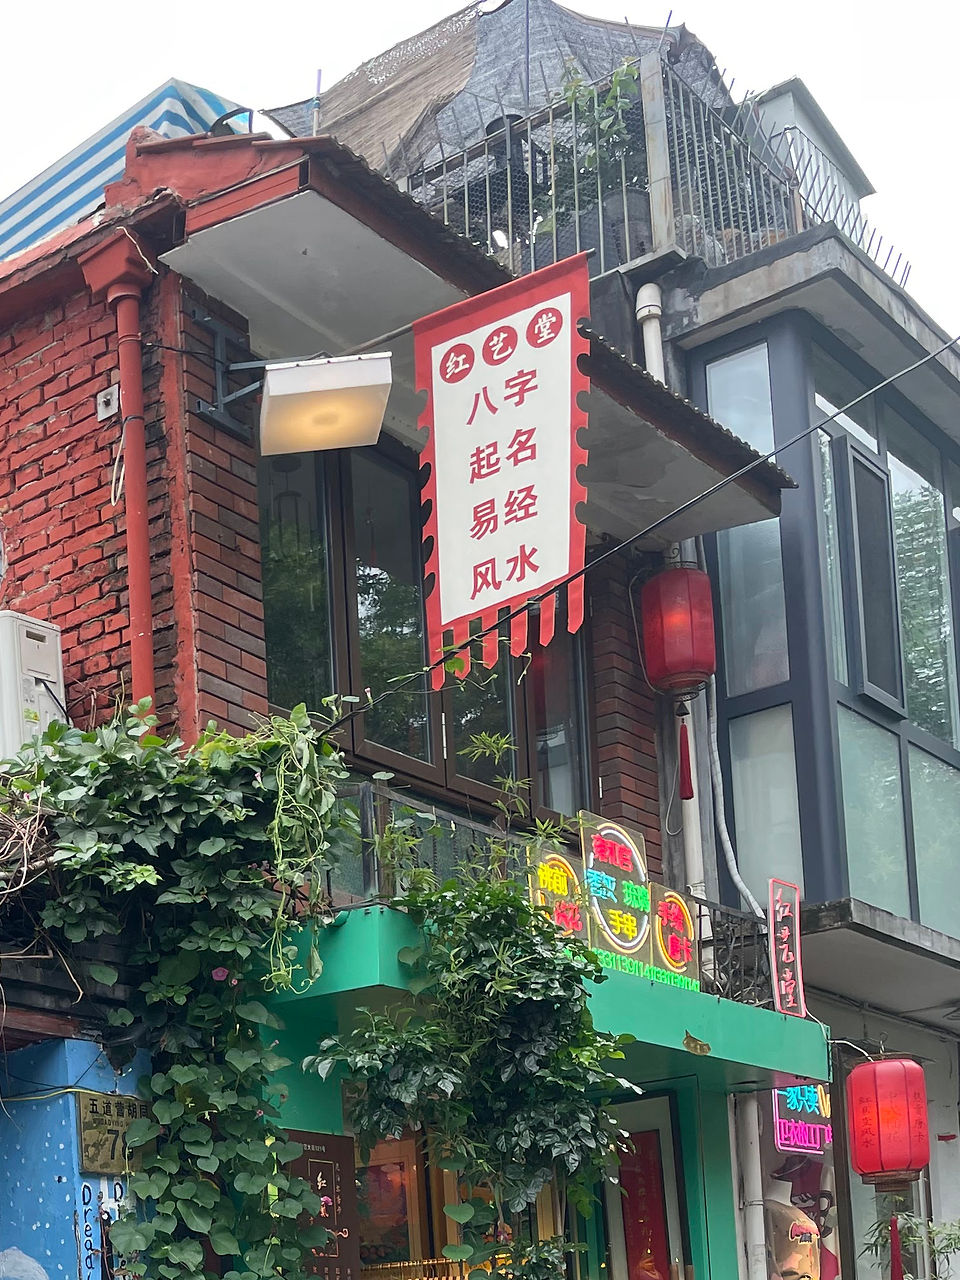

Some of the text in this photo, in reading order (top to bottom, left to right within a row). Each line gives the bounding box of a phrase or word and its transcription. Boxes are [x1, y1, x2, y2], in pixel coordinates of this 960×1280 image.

[444, 313, 558, 380] 红艺堂
[466, 370, 538, 426] 八字
[469, 428, 537, 485] 起名
[470, 484, 538, 541] 易经
[470, 545, 539, 601] 风水
[608, 909, 638, 941] 手串
